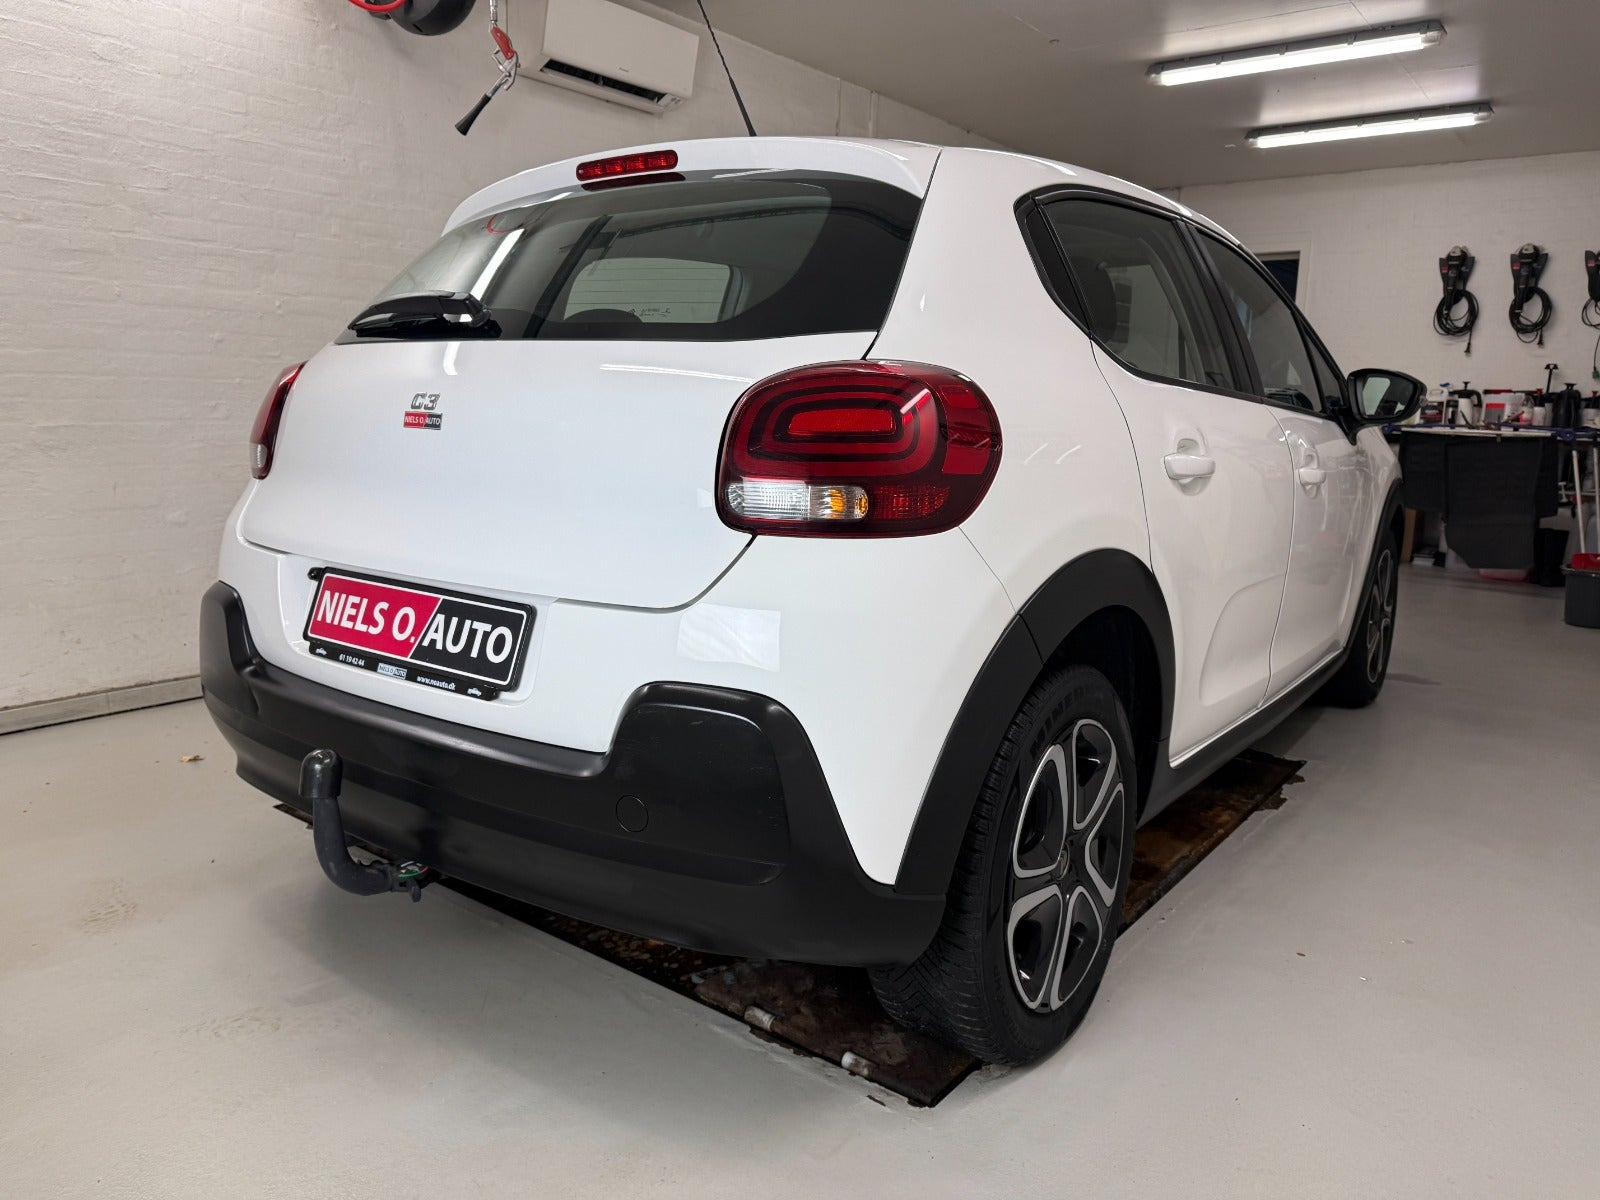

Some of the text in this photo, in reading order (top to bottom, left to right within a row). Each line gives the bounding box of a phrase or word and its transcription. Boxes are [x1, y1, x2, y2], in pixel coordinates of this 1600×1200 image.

[410, 392, 440, 410] C3
[404, 415, 419, 424] NIELS
[425, 417, 441, 425] AUTO
[316, 589, 513, 664] NIELS O. AUTO
[416, 675, 456, 691] www.noauto.dk
